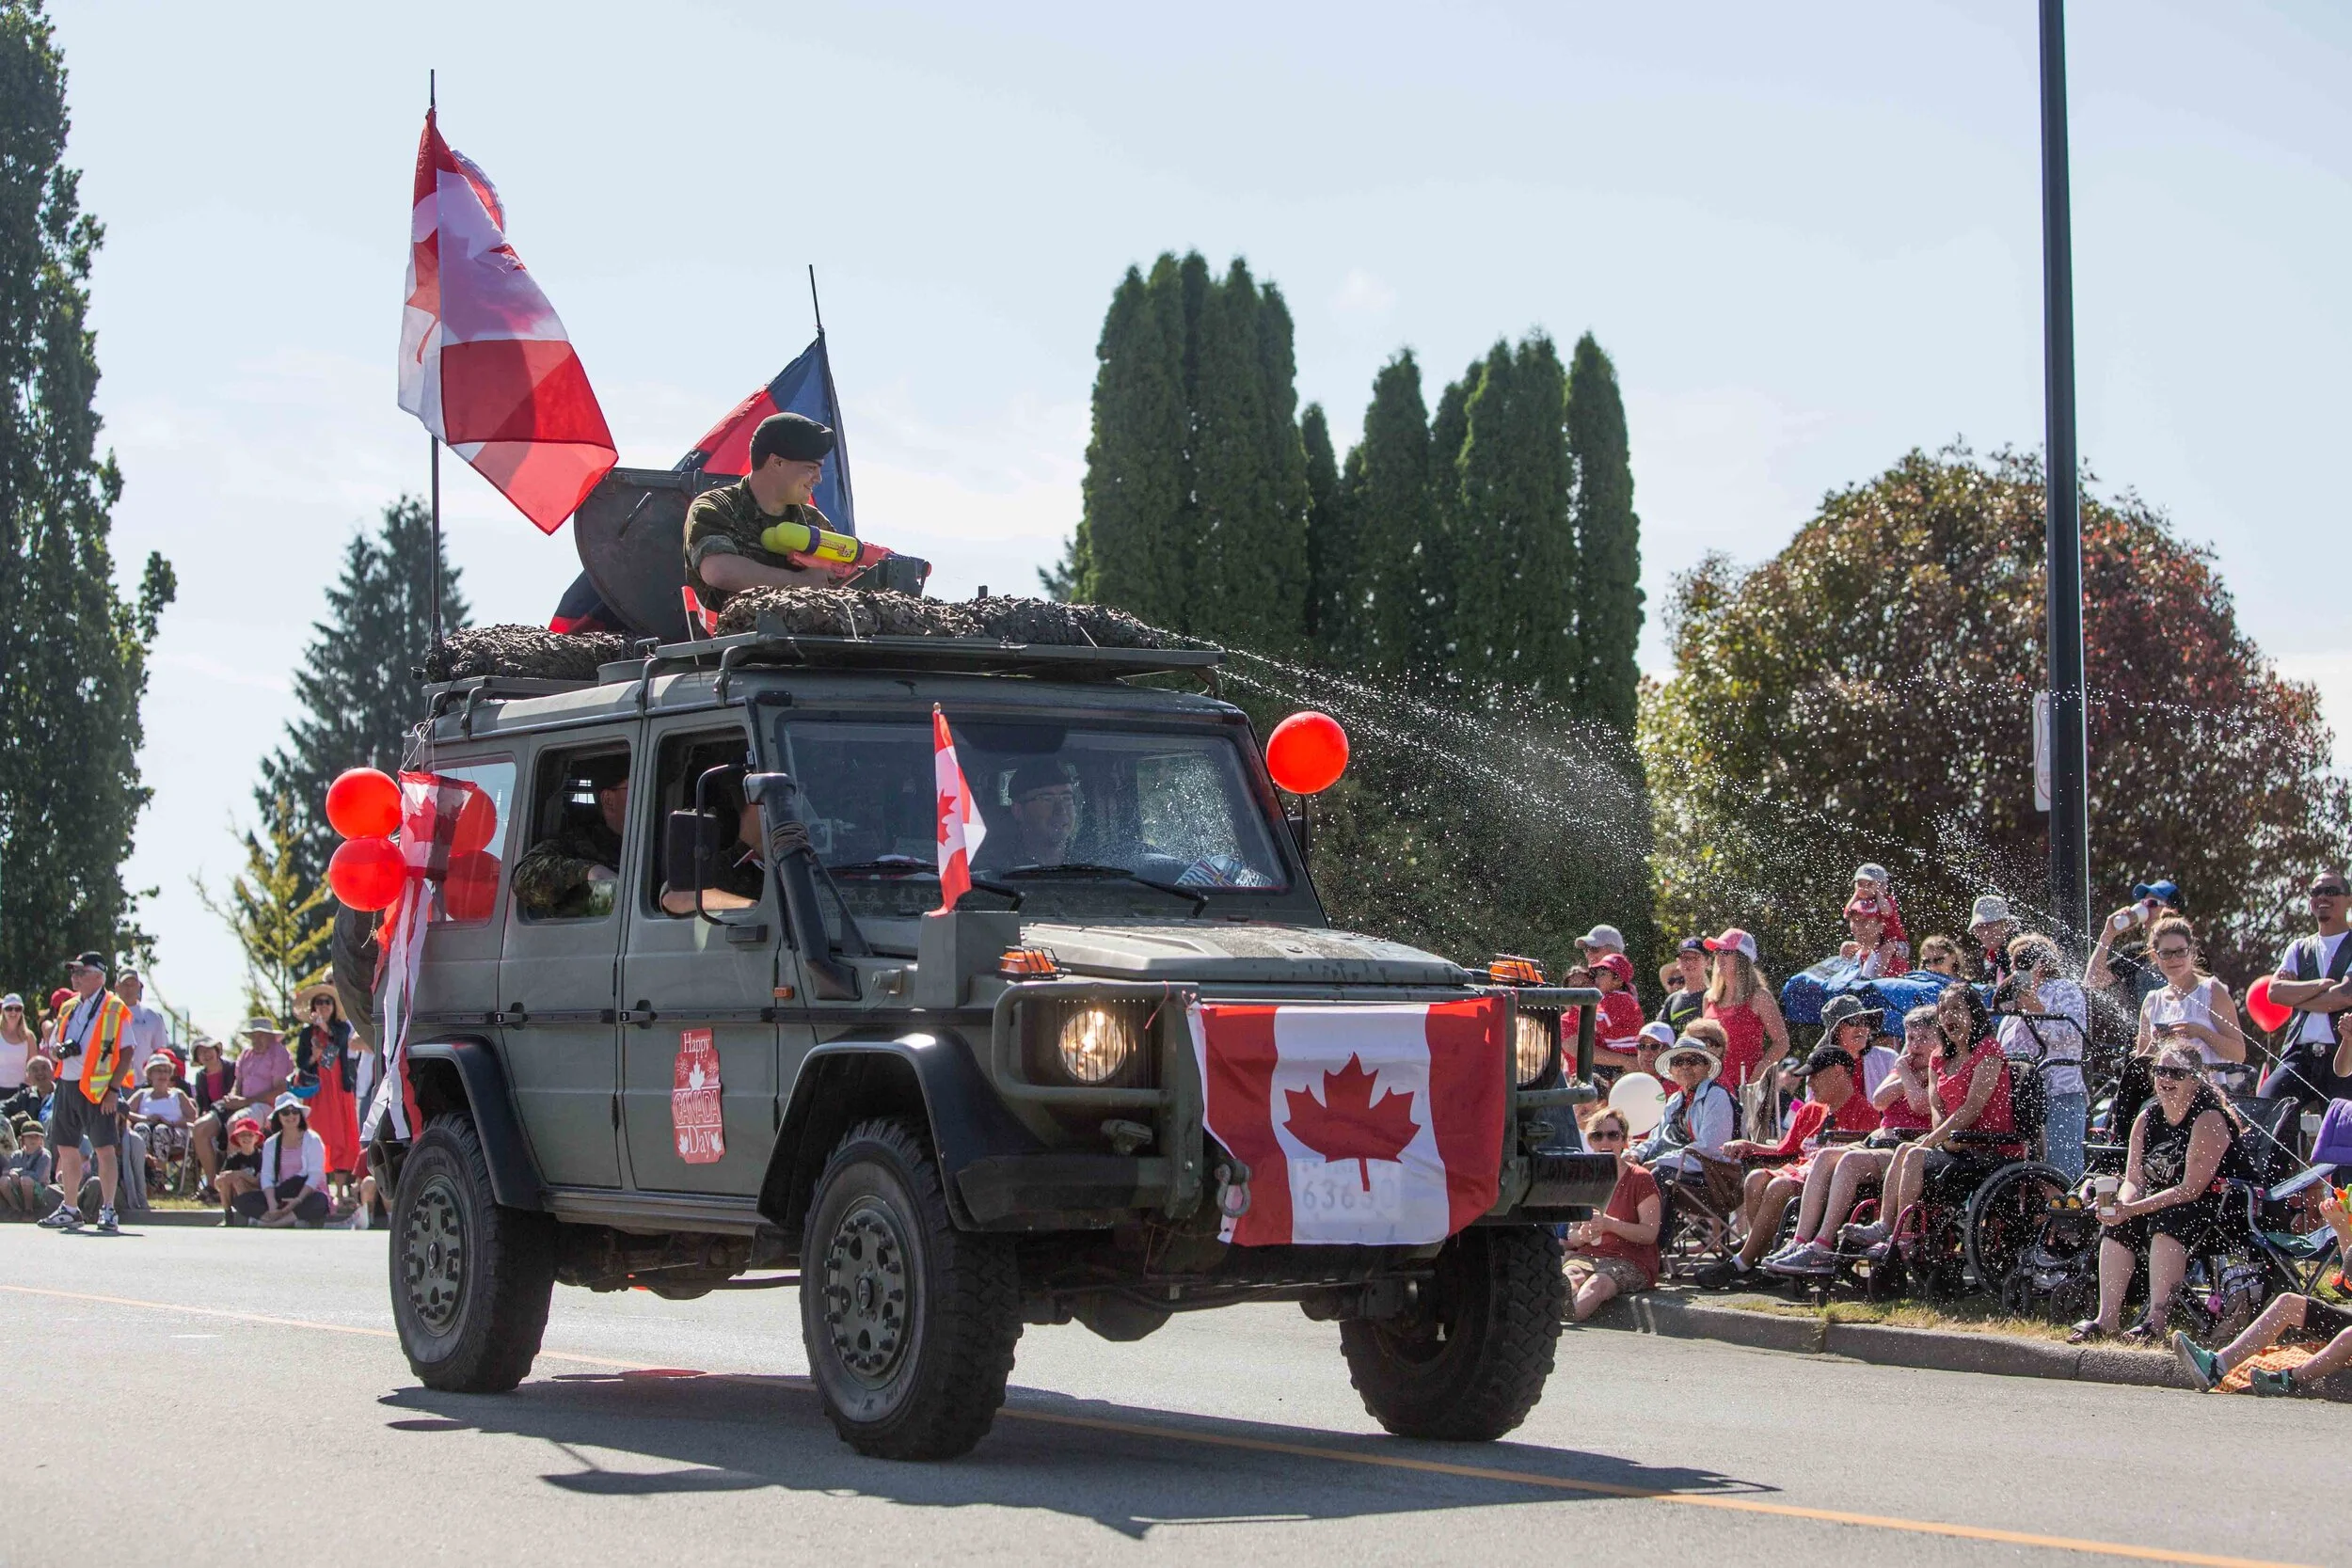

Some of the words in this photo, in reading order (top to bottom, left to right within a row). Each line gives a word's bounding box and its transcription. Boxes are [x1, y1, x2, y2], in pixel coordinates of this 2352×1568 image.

[683, 1033, 710, 1058] Happy
[674, 1090, 722, 1125] CANADA
[687, 1125, 711, 1159] Day
